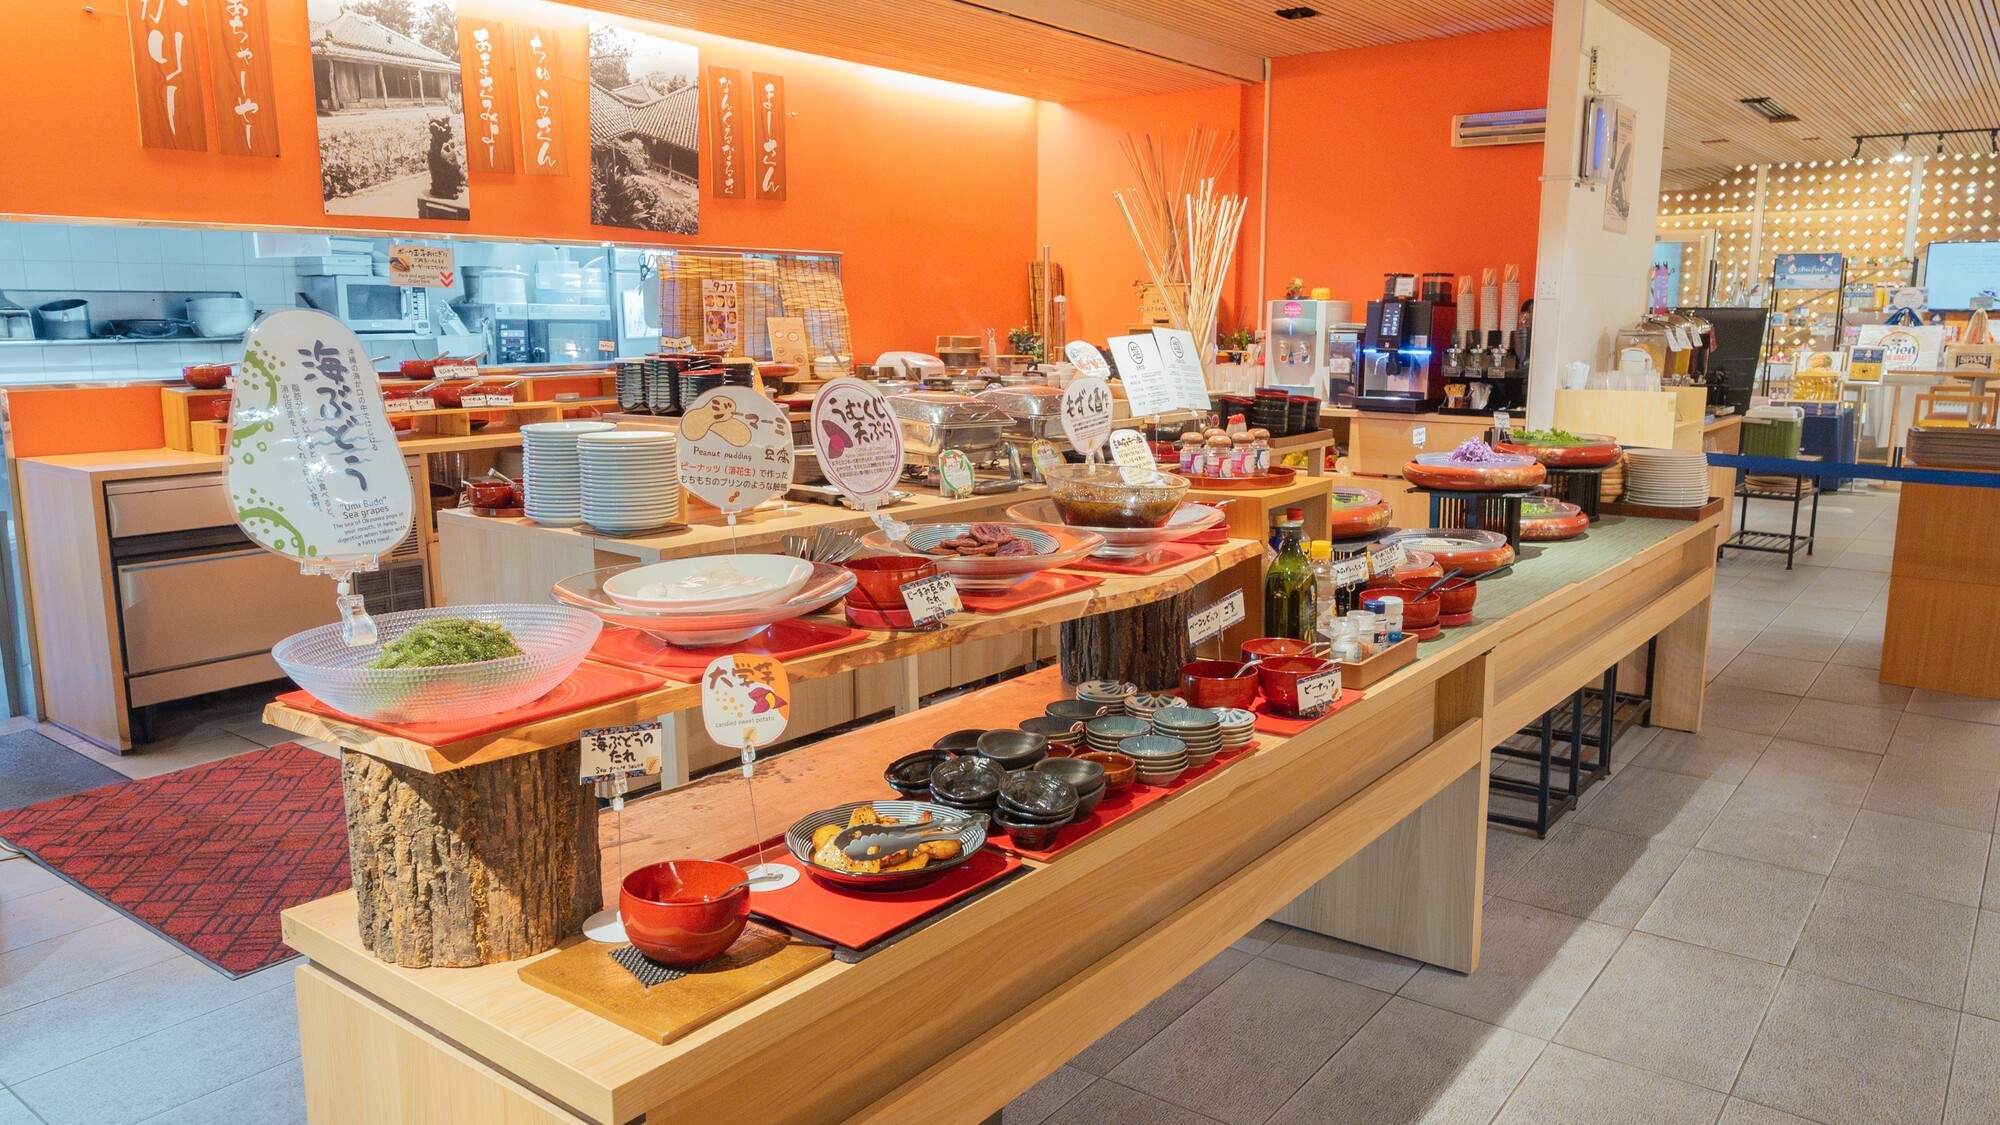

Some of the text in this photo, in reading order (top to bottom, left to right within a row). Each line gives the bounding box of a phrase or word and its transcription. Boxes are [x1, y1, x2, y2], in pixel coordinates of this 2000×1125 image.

[530, 35, 556, 167] ちゅらさん
[762, 82, 779, 192] まーさん
[713, 281, 734, 293] タコス
[1959, 354, 1988, 364] SPAM
[298, 340, 369, 492] 海ぶどう
[829, 396, 885, 424] うむくじ
[852, 421, 892, 445] 天ぷら
[693, 446, 752, 462] Peanut pudding
[764, 447, 789, 464] 豆腐
[680, 475, 788, 491] もちもちのプリンのような触感
[342, 506, 390, 519] Sea grapes
[361, 515, 385, 524] Okinawa
[926, 595, 941, 604] たれ
[709, 662, 775, 690] 大学芋
[1304, 679, 1335, 695] ピーナッツ
[715, 716, 775, 728] candied sweet potato
[591, 732, 653, 752] 海ぶどうの
[609, 749, 636, 763] たれ
